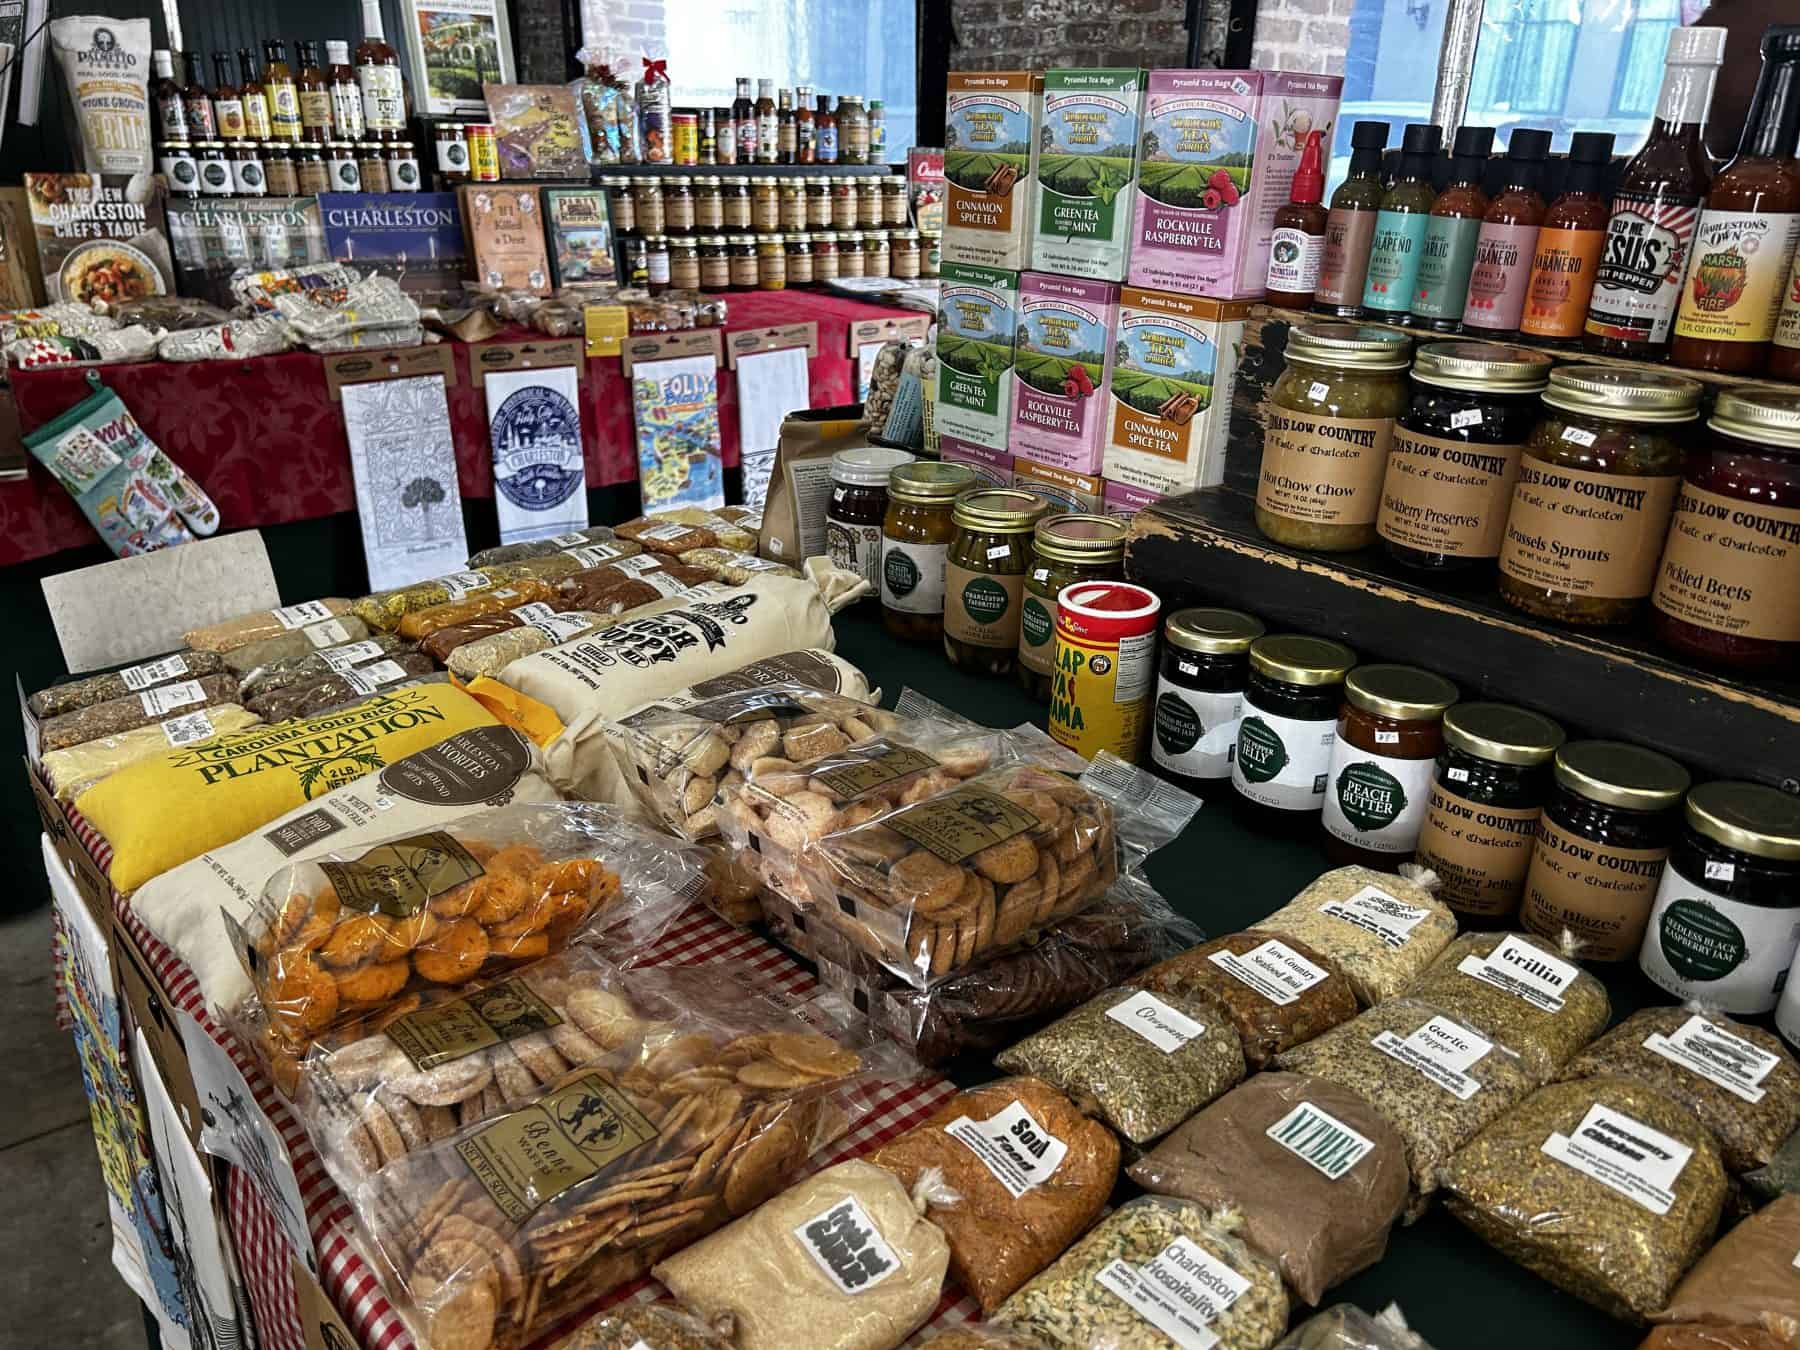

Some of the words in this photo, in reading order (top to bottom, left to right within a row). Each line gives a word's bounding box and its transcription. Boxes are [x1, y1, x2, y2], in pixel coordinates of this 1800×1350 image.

[1172, 79, 1199, 88] Pyramid
[1201, 79, 1213, 87] Tea
[1214, 80, 1231, 89] Bags
[975, 121, 994, 131] TEA
[1072, 122, 1097, 134] TEA
[1182, 129, 1210, 142] TEA
[66, 187, 91, 202] THE
[49, 203, 146, 221] CHARLESTON
[328, 208, 453, 228] CHARLESTON
[956, 200, 1003, 215] CINNAMON
[1054, 207, 1082, 219] GREEN
[1083, 210, 1099, 221] TEA
[181, 211, 309, 228] CHARLESTON
[960, 212, 981, 224] SPICE
[982, 214, 997, 225] TEA
[1072, 221, 1097, 233] MINT
[1156, 218, 1213, 235] ROCKVILLE
[1629, 222, 1645, 236] ME
[54, 221, 102, 238] CHEF'S
[108, 221, 146, 237] TABLE
[1145, 231, 1199, 247] RASPBERRY
[1203, 237, 1222, 249] TEA
[1711, 232, 1741, 246] OWN
[1703, 254, 1742, 268] MARSH
[1612, 271, 1655, 289] PEPPER
[1141, 296, 1165, 306] Pyramid
[1167, 300, 1177, 308] Tea
[1178, 302, 1193, 312] Bags
[1698, 298, 1727, 311] FIRE
[1151, 343, 1174, 355] TEA
[657, 375, 713, 400] FOLLY
[950, 380, 973, 394] GREEN
[974, 385, 987, 397] TEA
[965, 396, 985, 408] MINT
[1027, 400, 1072, 417] ROCKVILLE
[1019, 410, 1061, 429] RASPBERRY
[1064, 419, 1080, 433] TEA
[1124, 420, 1179, 442] CINNAMON
[1128, 433, 1153, 448] SPICE
[1155, 440, 1172, 453] TEA
[1292, 420, 1316, 434] LOW
[1318, 425, 1377, 448] COUNTRY
[1297, 444, 1308, 453] of
[1310, 446, 1361, 458] Charleston
[1414, 441, 1440, 458] LOW
[1443, 449, 1507, 476] COUNTRY
[1278, 476, 1312, 492] Chow
[1316, 483, 1357, 497] Chow
[1419, 469, 1431, 478] of
[1433, 472, 1488, 487] Charleston
[1542, 473, 1571, 490] LOW
[1573, 481, 1647, 512] COUNTRY
[1425, 508, 1480, 528] Preserves
[1547, 501, 1560, 511] of
[1562, 504, 1625, 522] Charleston
[1698, 501, 1731, 521] LOW
[1732, 511, 1800, 545] COUNTR
[1507, 522, 1546, 552] Brussels
[1549, 539, 1611, 563] Sprouts
[1702, 532, 1716, 542] of
[1718, 536, 1787, 558] Charleston
[1664, 560, 1705, 590] Pickled
[1706, 577, 1753, 602] Beets
[965, 591, 1005, 603] CHARLESTON
[623, 648, 646, 665] MIX
[1055, 642, 1085, 675] LAP
[213, 729, 304, 760] CAROLINA
[306, 716, 347, 735] GOLD
[354, 703, 396, 723] RICE
[197, 705, 446, 786] PLANTATION
[456, 736, 504, 770] ARLESTON
[1242, 742, 1273, 764] JELLY
[1251, 741, 1275, 757] PEPPER
[330, 768, 338, 777] 2
[340, 766, 358, 776] LB.
[1347, 780, 1393, 802] PEACH
[1343, 789, 1393, 815] BUTTER
[1445, 800, 1475, 820] LOW
[305, 814, 332, 832] FOOD
[278, 827, 303, 848] SOUL
[1451, 829, 1464, 838] of
[1465, 832, 1524, 849] Charleston
[1560, 840, 1595, 861] LOW
[1567, 871, 1582, 880] of
[1584, 874, 1648, 893] Charleston
[1531, 888, 1558, 914] Blue
[1562, 908, 1621, 931] Blazes
[1664, 926, 1711, 957] RASPBERRY
[1712, 948, 1734, 962] JAM
[1665, 916, 1703, 943] SEEDLESS
[1704, 936, 1738, 955] BLACK
[1251, 955, 1282, 978] Seafood
[1281, 972, 1303, 990] Boil
[1266, 945, 1284, 959] Low
[1284, 956, 1316, 982] Country
[1502, 947, 1563, 987] Grillin
[1418, 1031, 1453, 1054] Pepper
[1428, 1023, 1470, 1052] Garlic
[522, 1120, 575, 1175] Benne
[1010, 1117, 1051, 1159] Soul
[1581, 1127, 1646, 1162] Chicken
[1593, 1118, 1674, 1161] Lowcountry
[460, 1140, 479, 1164] NET
[518, 1135, 550, 1176] WAFERS
[992, 1135, 1036, 1172] Food
[806, 1220, 869, 1289] GARLIC
[1164, 1243, 1238, 1302] Charleston
[1144, 1259, 1218, 1320] Hospitality
